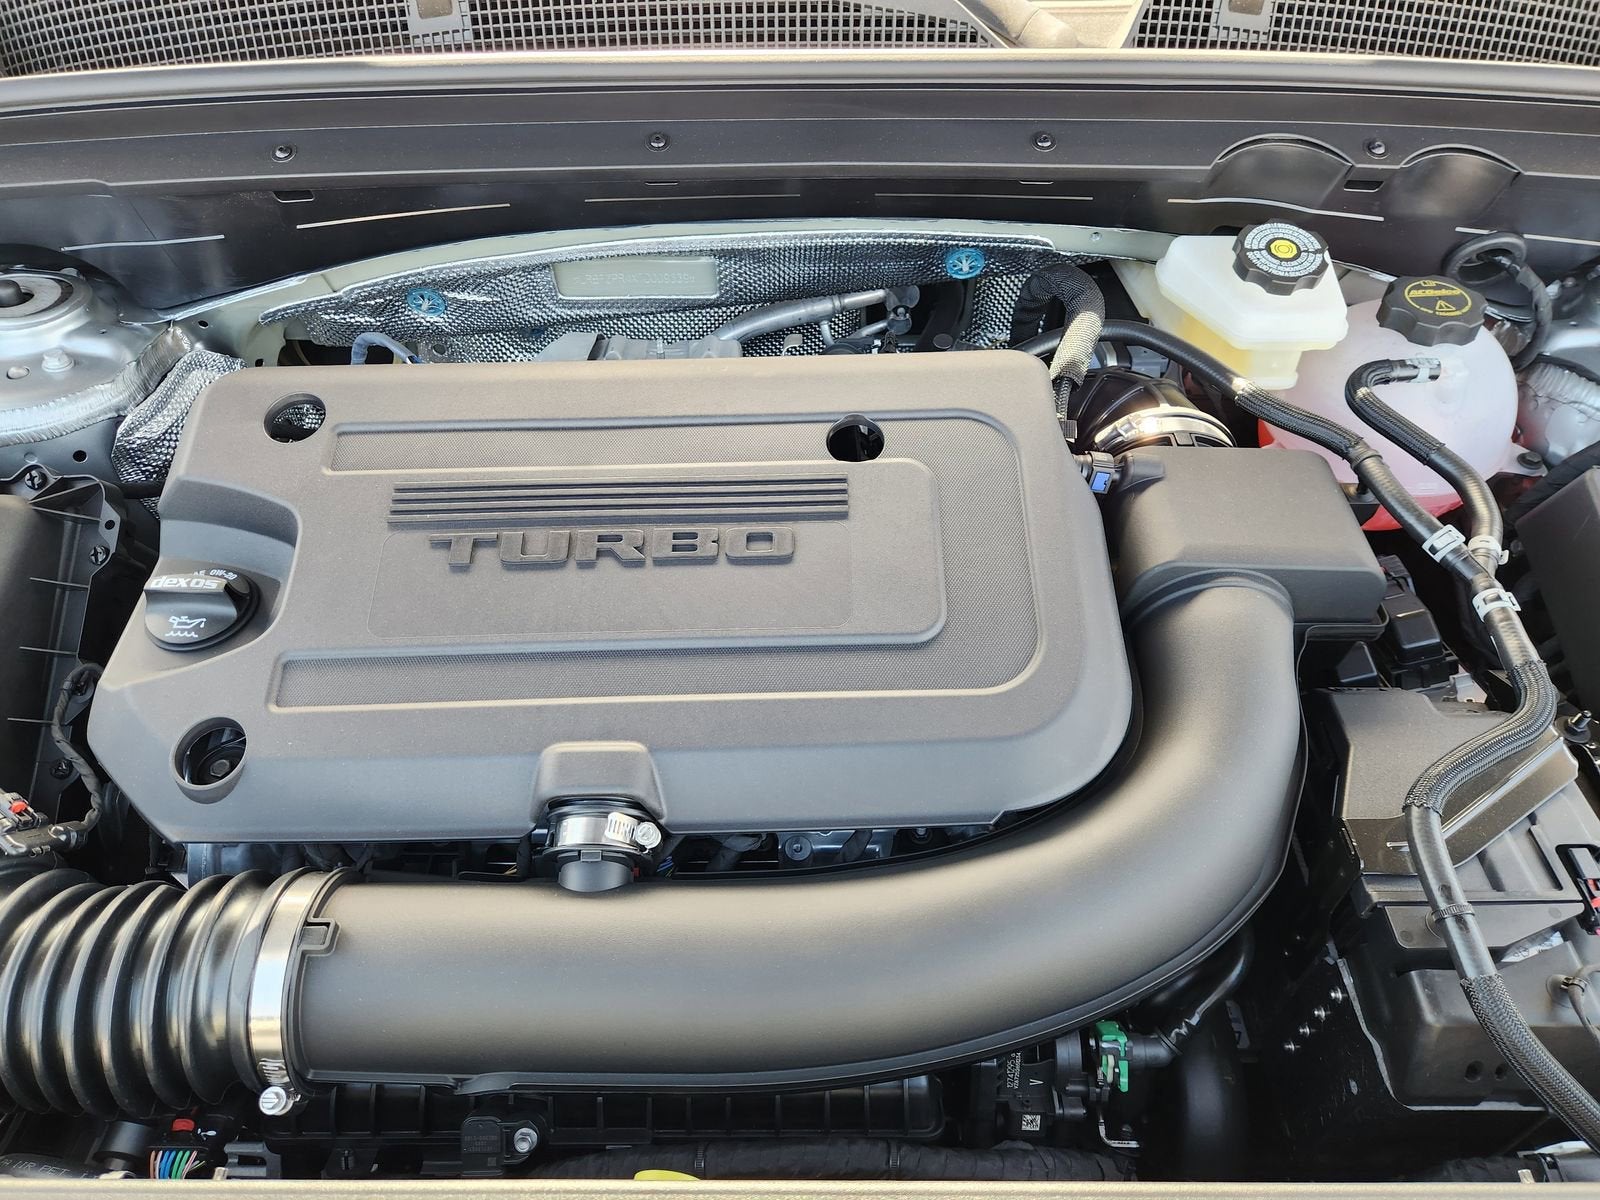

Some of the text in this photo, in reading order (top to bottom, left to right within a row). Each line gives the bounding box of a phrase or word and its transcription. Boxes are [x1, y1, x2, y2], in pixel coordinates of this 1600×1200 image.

[429, 527, 795, 567] TURBO
[209, 569, 238, 580] 0W-20
[150, 576, 219, 589] dexos
